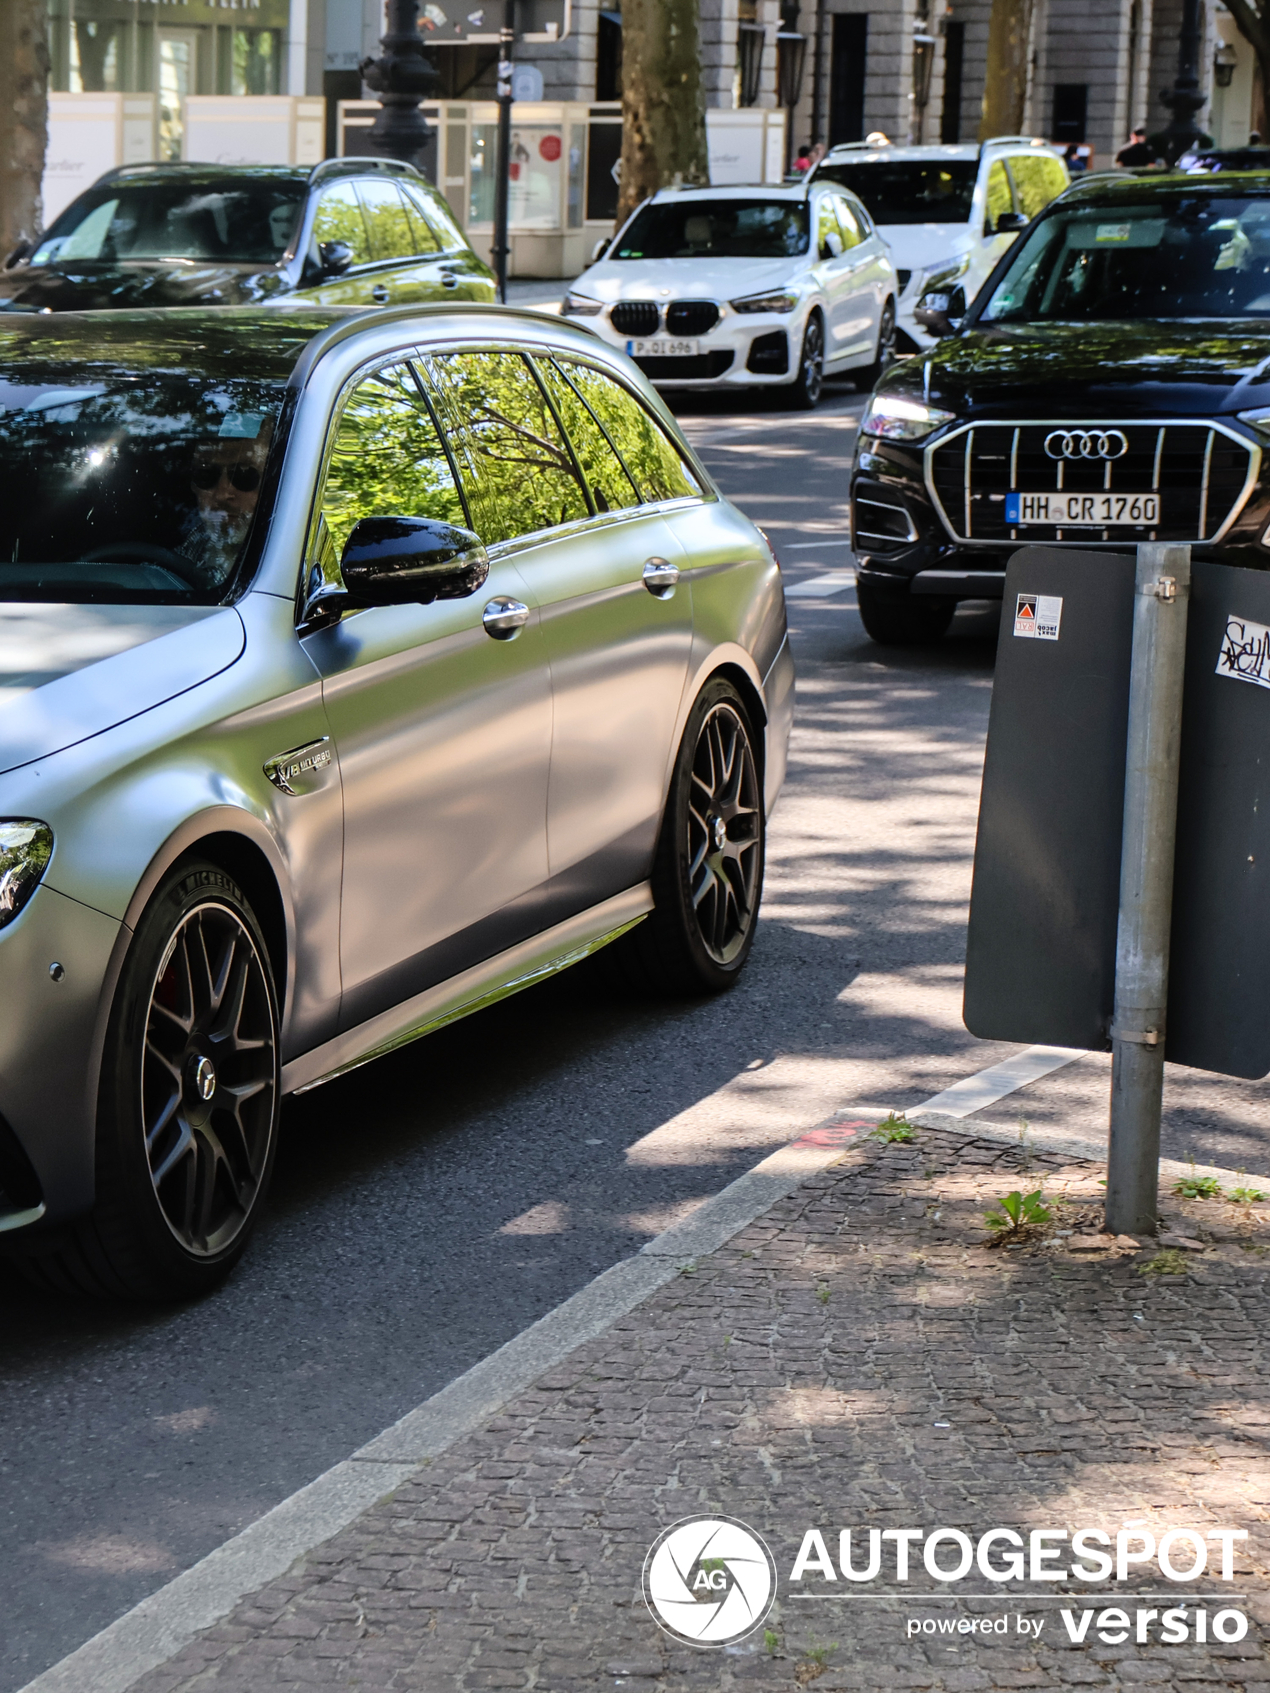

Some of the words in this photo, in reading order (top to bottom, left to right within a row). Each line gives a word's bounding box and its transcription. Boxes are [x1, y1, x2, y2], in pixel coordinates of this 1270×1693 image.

[1022, 496, 1050, 520] HH
[1067, 497, 1094, 520] CR
[1101, 497, 1156, 520] 1760
